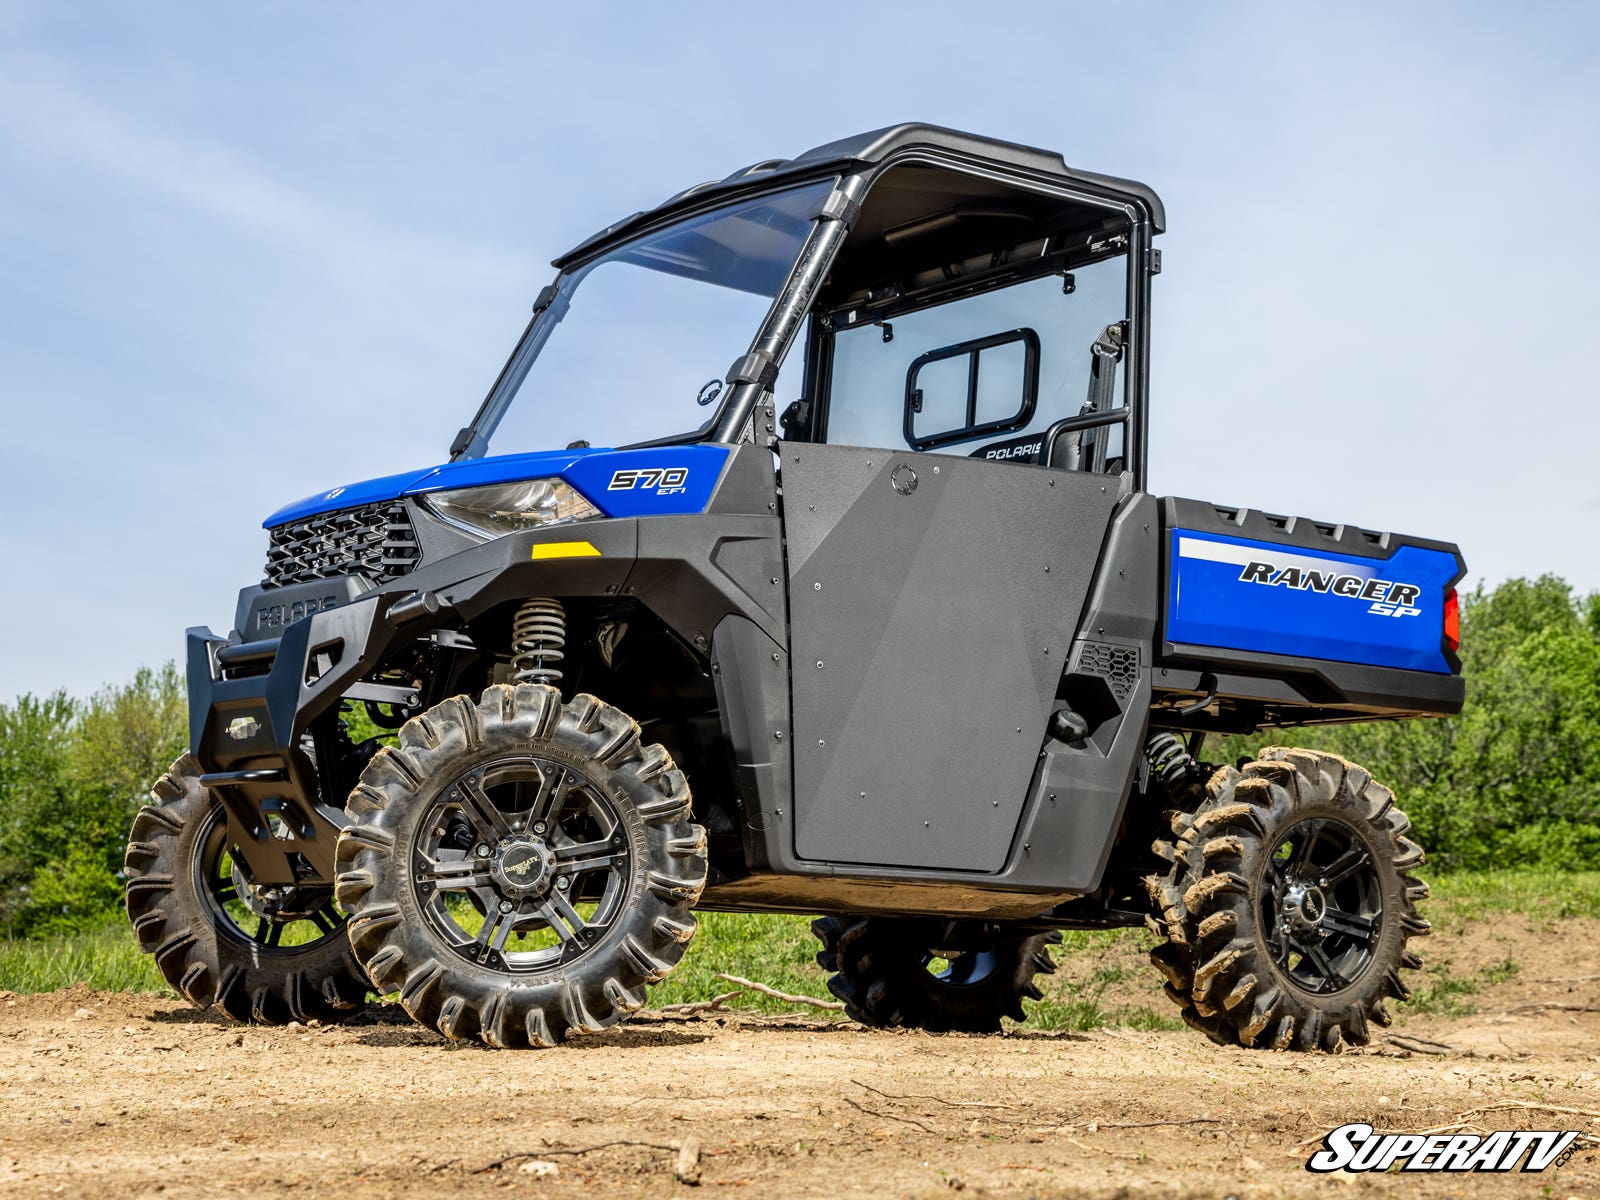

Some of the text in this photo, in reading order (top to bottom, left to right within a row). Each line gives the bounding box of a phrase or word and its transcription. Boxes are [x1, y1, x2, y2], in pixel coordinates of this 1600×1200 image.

[986, 442, 1042, 459] POLARIS
[607, 467, 688, 490] 570
[656, 487, 686, 495] EFI
[1238, 560, 1420, 606] RANGER
[1367, 602, 1422, 617] SP
[614, 786, 648, 908] TERMINATOR
